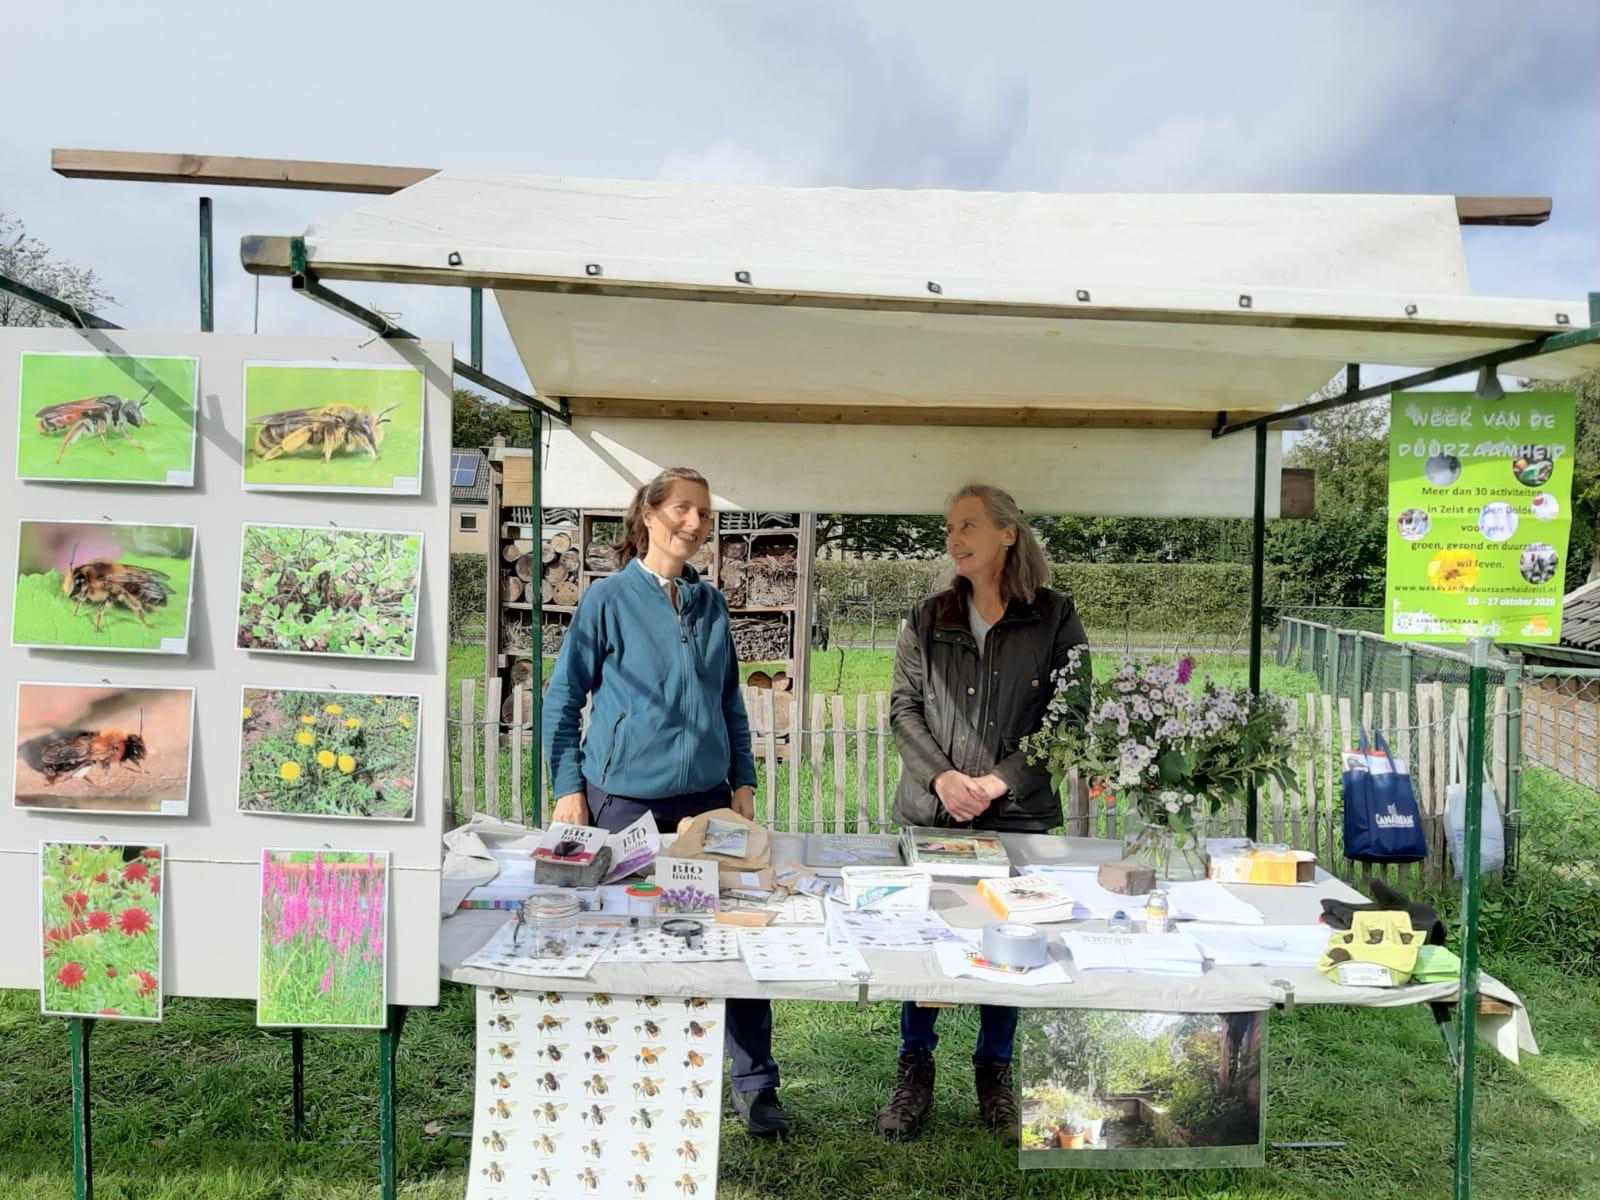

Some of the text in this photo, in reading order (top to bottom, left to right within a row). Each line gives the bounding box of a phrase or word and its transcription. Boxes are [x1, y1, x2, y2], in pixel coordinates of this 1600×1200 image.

[1411, 406, 1555, 429] WEEK VAN DE
[1399, 440, 1566, 460] DUURZAAMHEID
[1422, 487, 1543, 498] Meer dan 30 activiteiten
[1427, 504, 1437, 514] in
[1440, 505, 1464, 514] Zeist
[1468, 506, 1480, 514] en
[1483, 505, 1503, 514] Den
[1461, 525, 1484, 533] voor
[1411, 541, 1444, 552] groen,
[1446, 541, 1484, 552] gezond
[1486, 542, 1498, 551] en
[1456, 559, 1505, 569] wil leven.
[1466, 597, 1479, 606] 10
[1487, 597, 1498, 606] 17
[563, 828, 593, 839] BIO
[622, 827, 647, 848] BIO
[672, 864, 703, 875] BIO
[672, 873, 703, 881] bulbs
